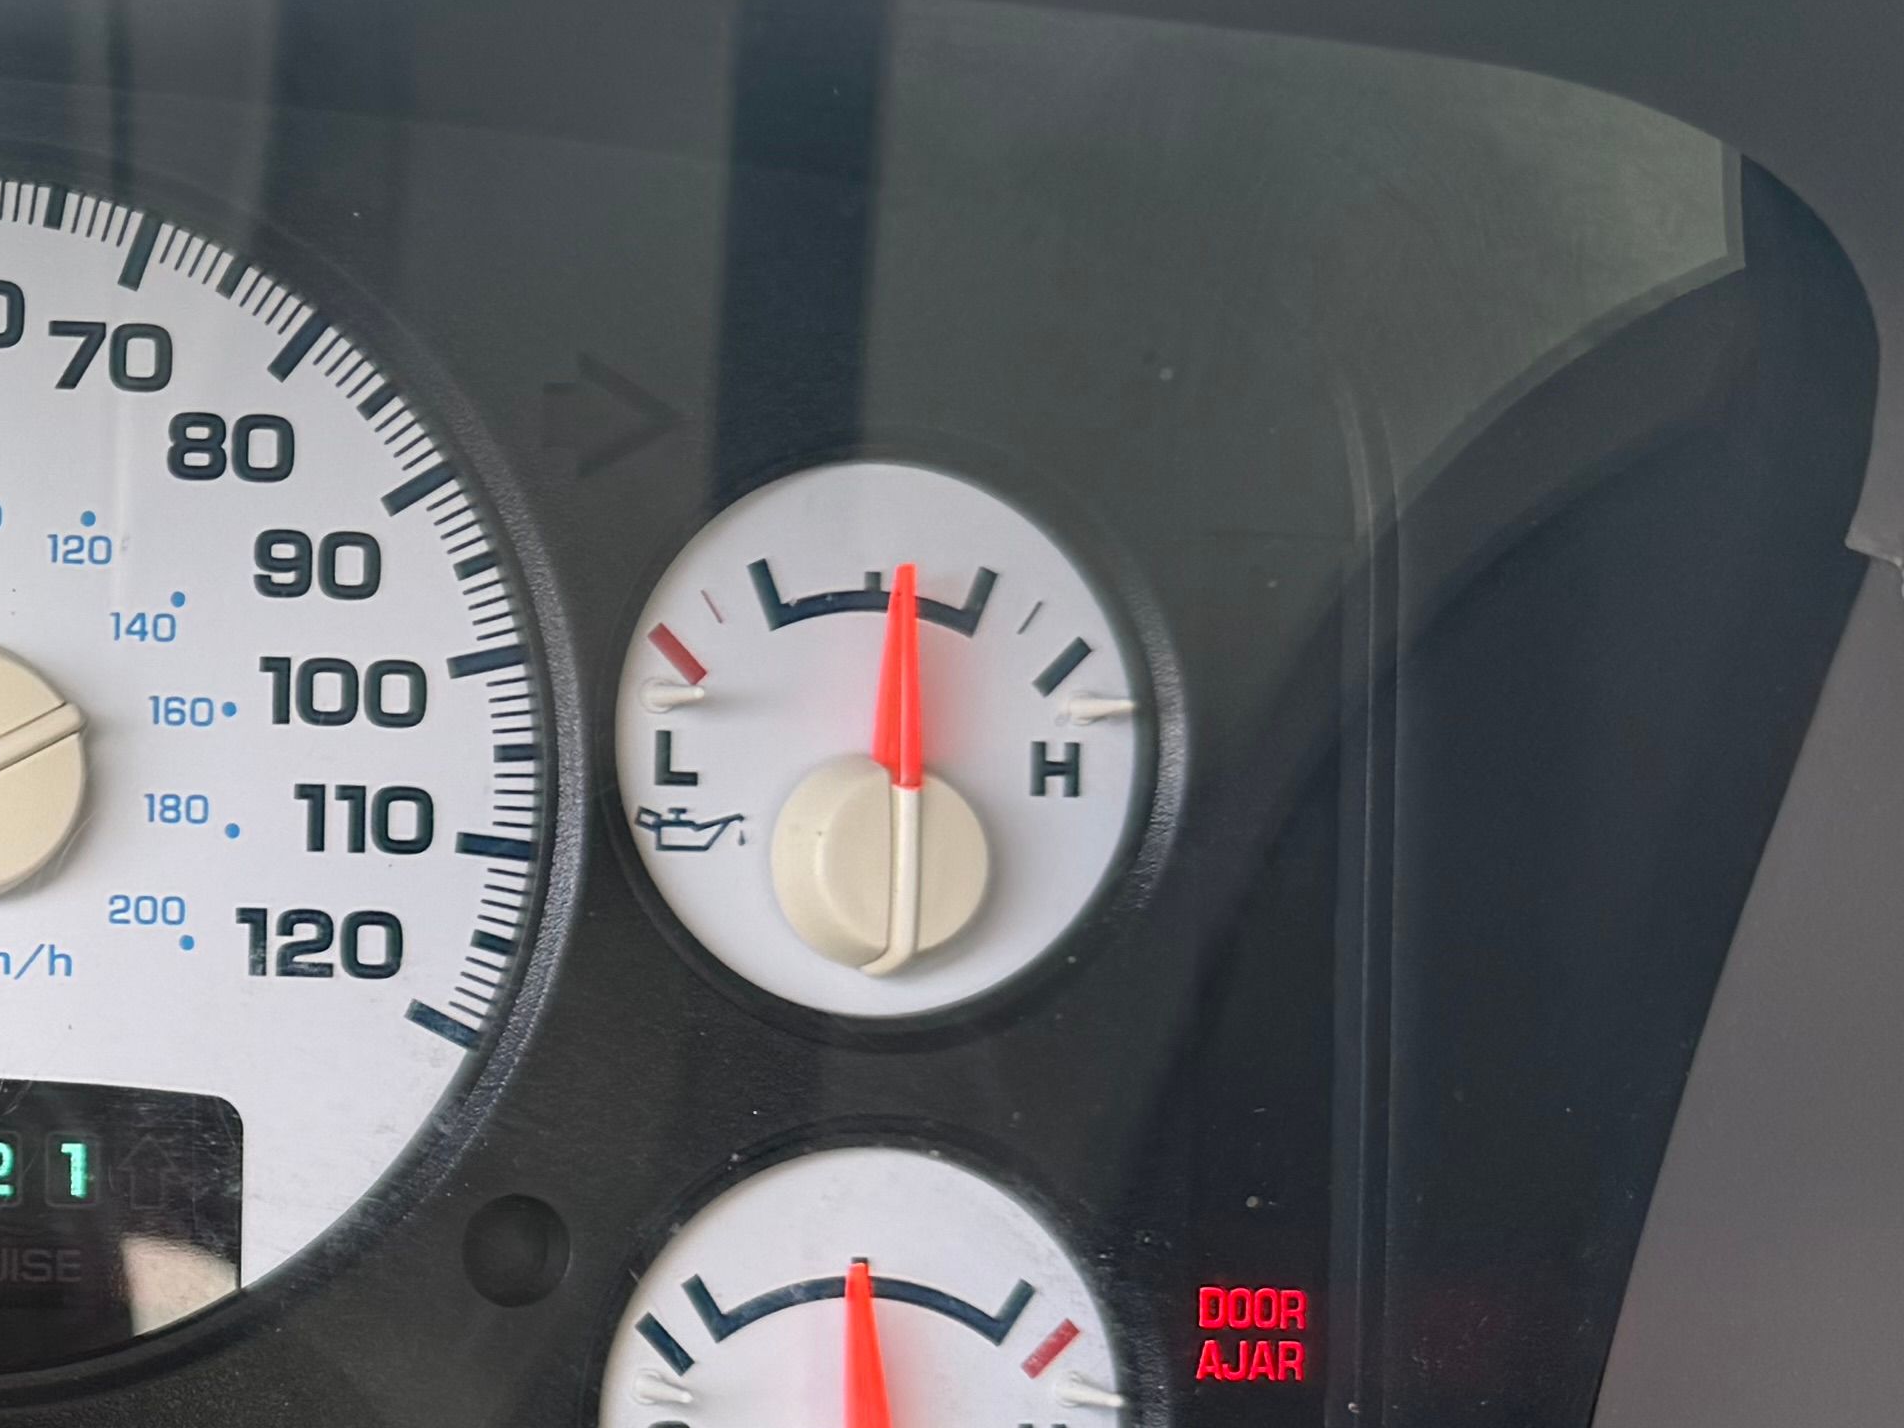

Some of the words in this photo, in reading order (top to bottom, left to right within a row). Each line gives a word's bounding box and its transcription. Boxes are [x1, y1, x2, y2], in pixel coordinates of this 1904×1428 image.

[49, 321, 173, 392] 70
[168, 412, 295, 482] 80
[48, 534, 112, 564] 120
[255, 529, 381, 600] 90
[112, 612, 176, 642] 140
[150, 696, 214, 726] 160
[260, 657, 427, 728] 100
[655, 730, 698, 786] L
[1032, 742, 1080, 797] H
[145, 794, 208, 824] 180
[295, 784, 434, 854] 110
[109, 895, 185, 925] 200
[237, 908, 403, 979] 120
[60, 1143, 88, 1197] 1
[1198, 1286, 1307, 1330] DOOR
[1195, 1339, 1305, 1382] AJAR
